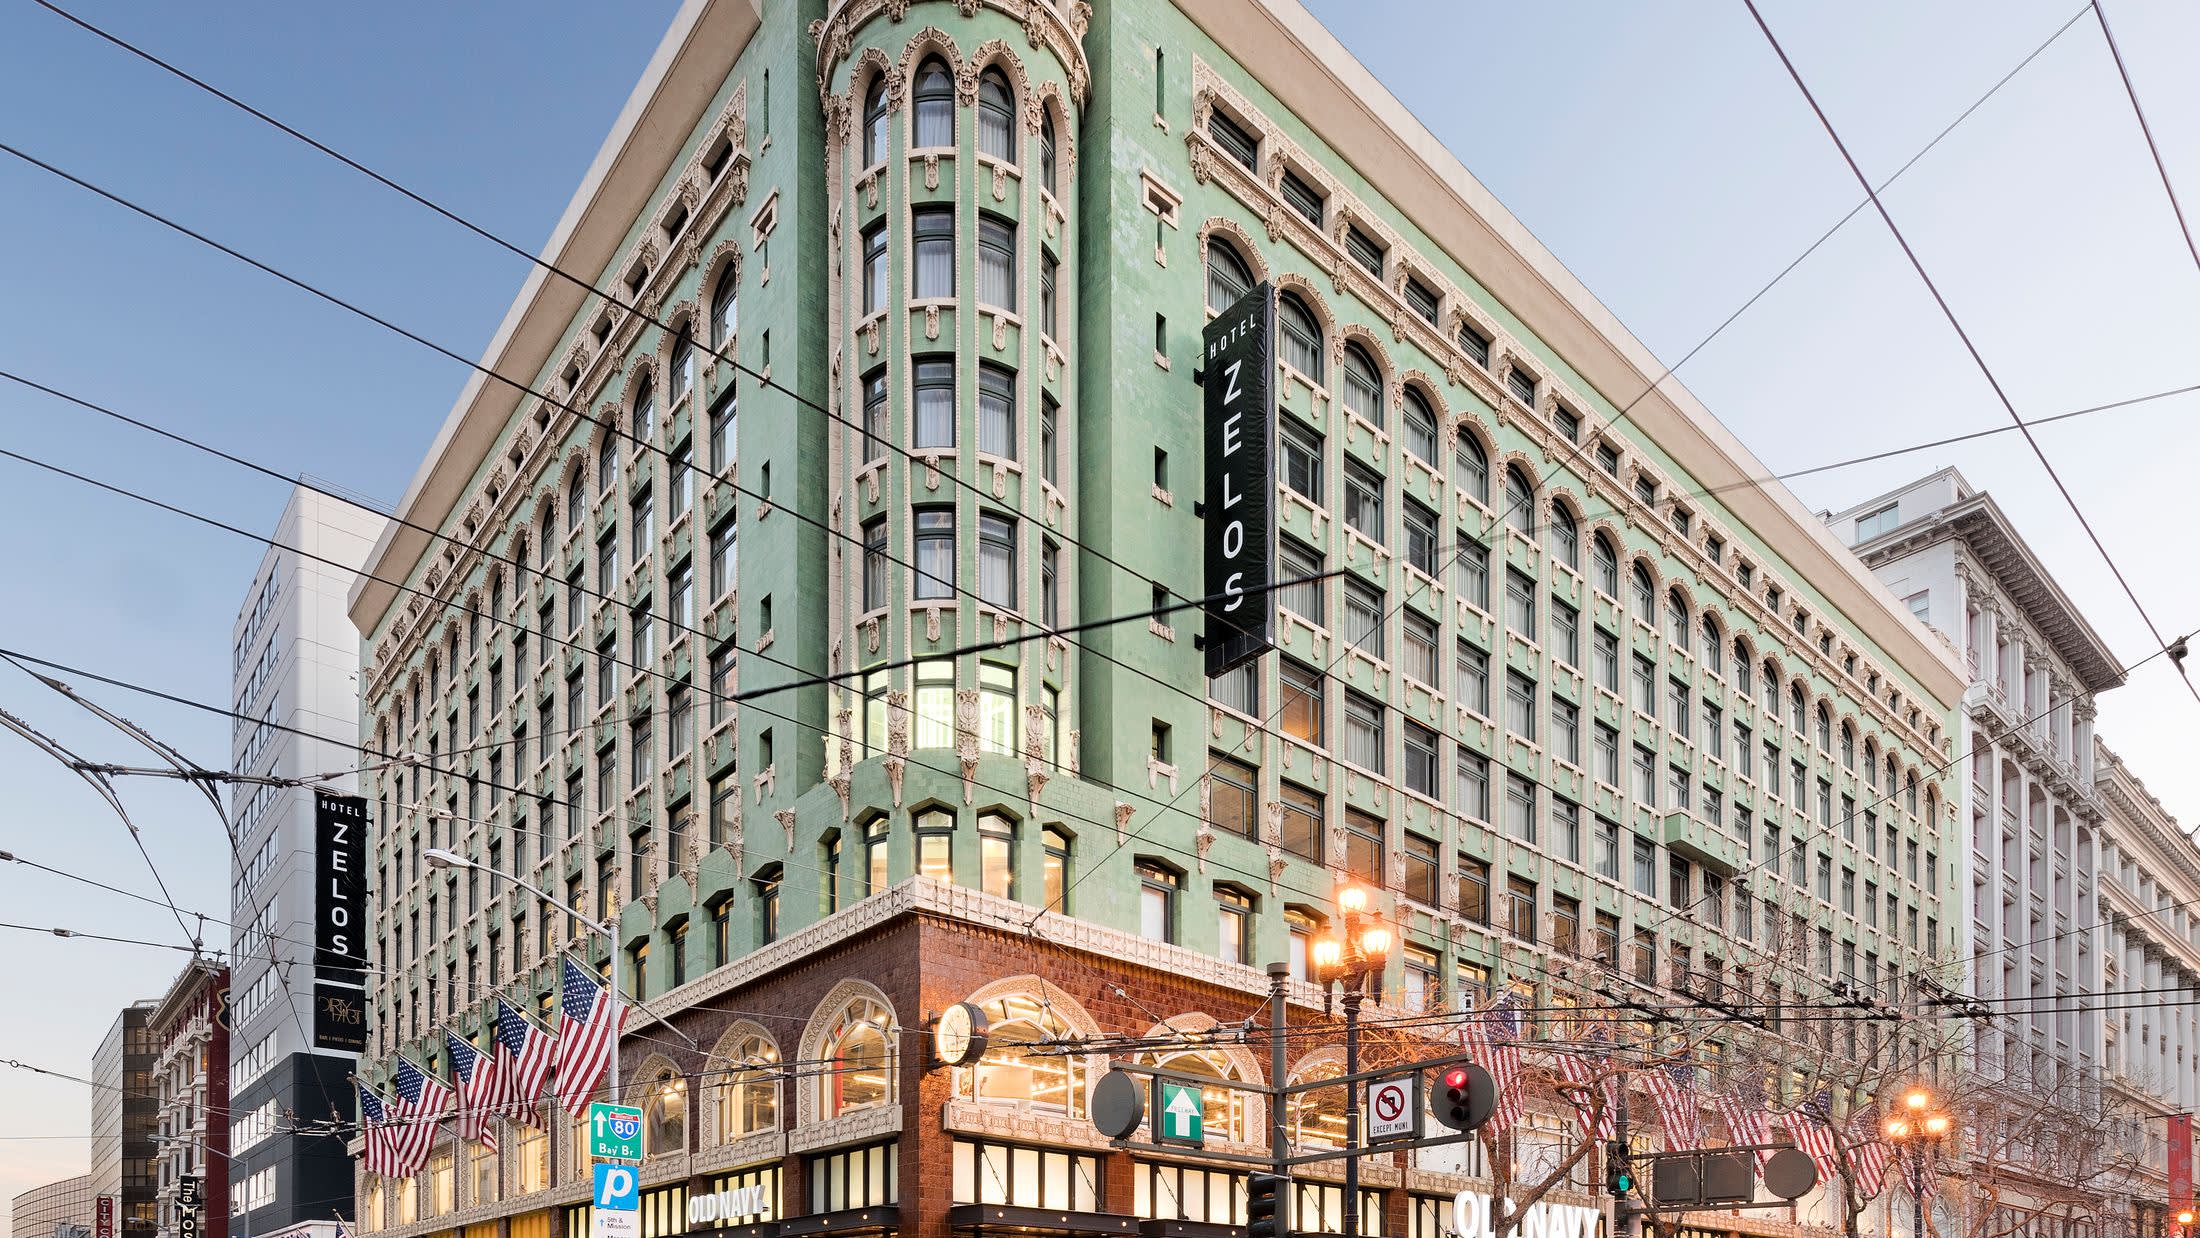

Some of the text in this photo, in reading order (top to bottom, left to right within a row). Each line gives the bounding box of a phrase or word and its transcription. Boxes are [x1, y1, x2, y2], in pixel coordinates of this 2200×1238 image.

[1209, 313, 1256, 360] HOTEL
[1223, 359, 1243, 612] ZELOS
[321, 800, 360, 817] HOTEL
[331, 822, 349, 955] ZELOS
[614, 1120, 634, 1136] 80
[1373, 1121, 1408, 1134] EXCEPT MUNI
[599, 1142, 634, 1156] Bay Br
[182, 1180, 196, 1203] The
[689, 1185, 764, 1224] OLD NAVY
[99, 1199, 110, 1227] CITY
[1521, 1200, 1600, 1238] NAVY
